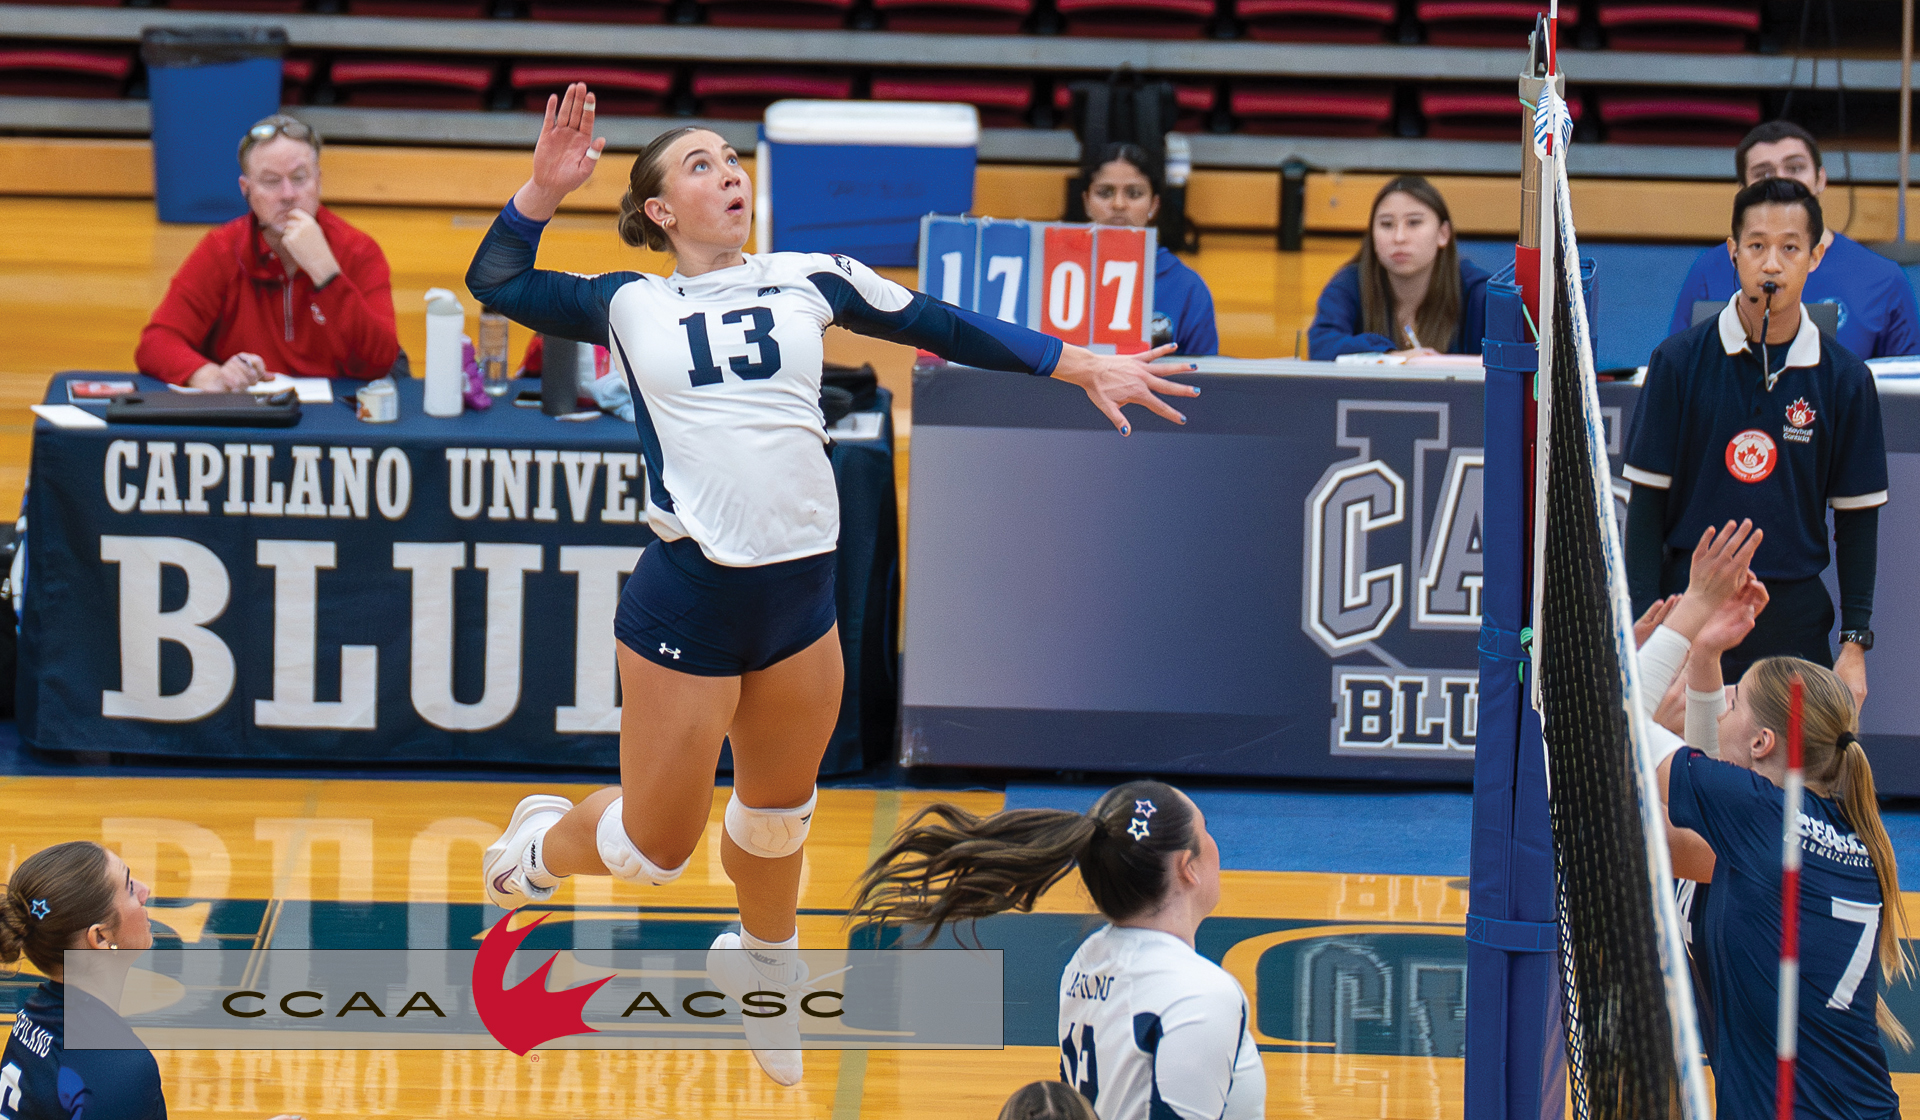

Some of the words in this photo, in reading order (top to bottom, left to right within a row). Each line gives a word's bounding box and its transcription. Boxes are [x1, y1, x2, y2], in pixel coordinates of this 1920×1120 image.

[679, 306, 782, 388] 13
[104, 439, 411, 521] CAPILANO
[1825, 896, 1883, 1011] 7
